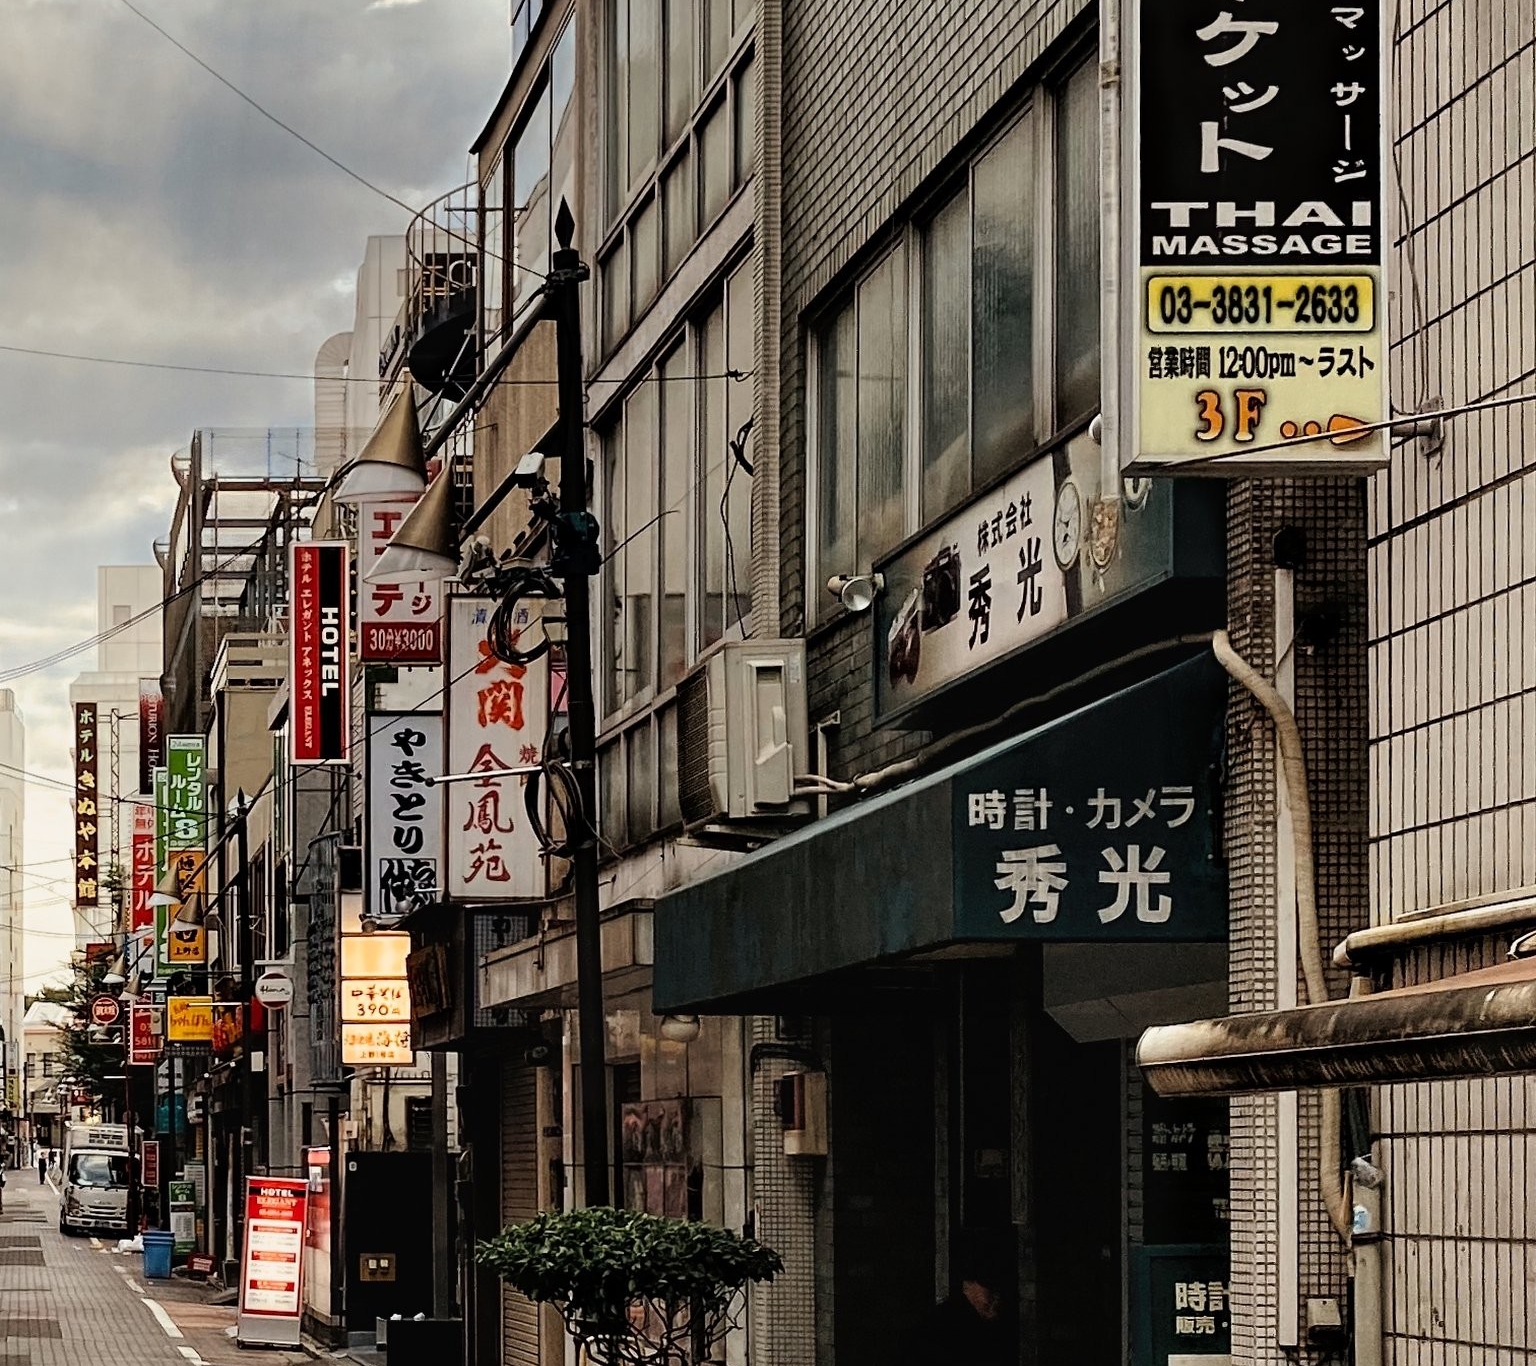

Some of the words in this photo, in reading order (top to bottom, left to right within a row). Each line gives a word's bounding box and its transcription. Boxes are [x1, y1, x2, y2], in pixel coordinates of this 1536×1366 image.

[1151, 200, 1372, 228] THAI
[1152, 234, 1372, 256] MASSAGE
[1160, 284, 1360, 325] 03-3831-2633
[1148, 346, 1211, 379] 営業時間
[976, 490, 1034, 557] 株式会社
[300, 551, 313, 584] ホテル
[967, 535, 1044, 651] 秀光
[300, 588, 313, 643] エレガント
[369, 628, 434, 652] 30分¥3000
[301, 646, 313, 700] アネックス
[321, 607, 339, 697] HOTEL
[186, 752, 203, 811] レンタル
[390, 728, 427, 854] やきとり
[967, 785, 1196, 831] 時計・カメラ
[462, 742, 515, 884] 金鳳苑
[994, 843, 1173, 924] 秀光
[260, 1187, 294, 1198] HOTEL
